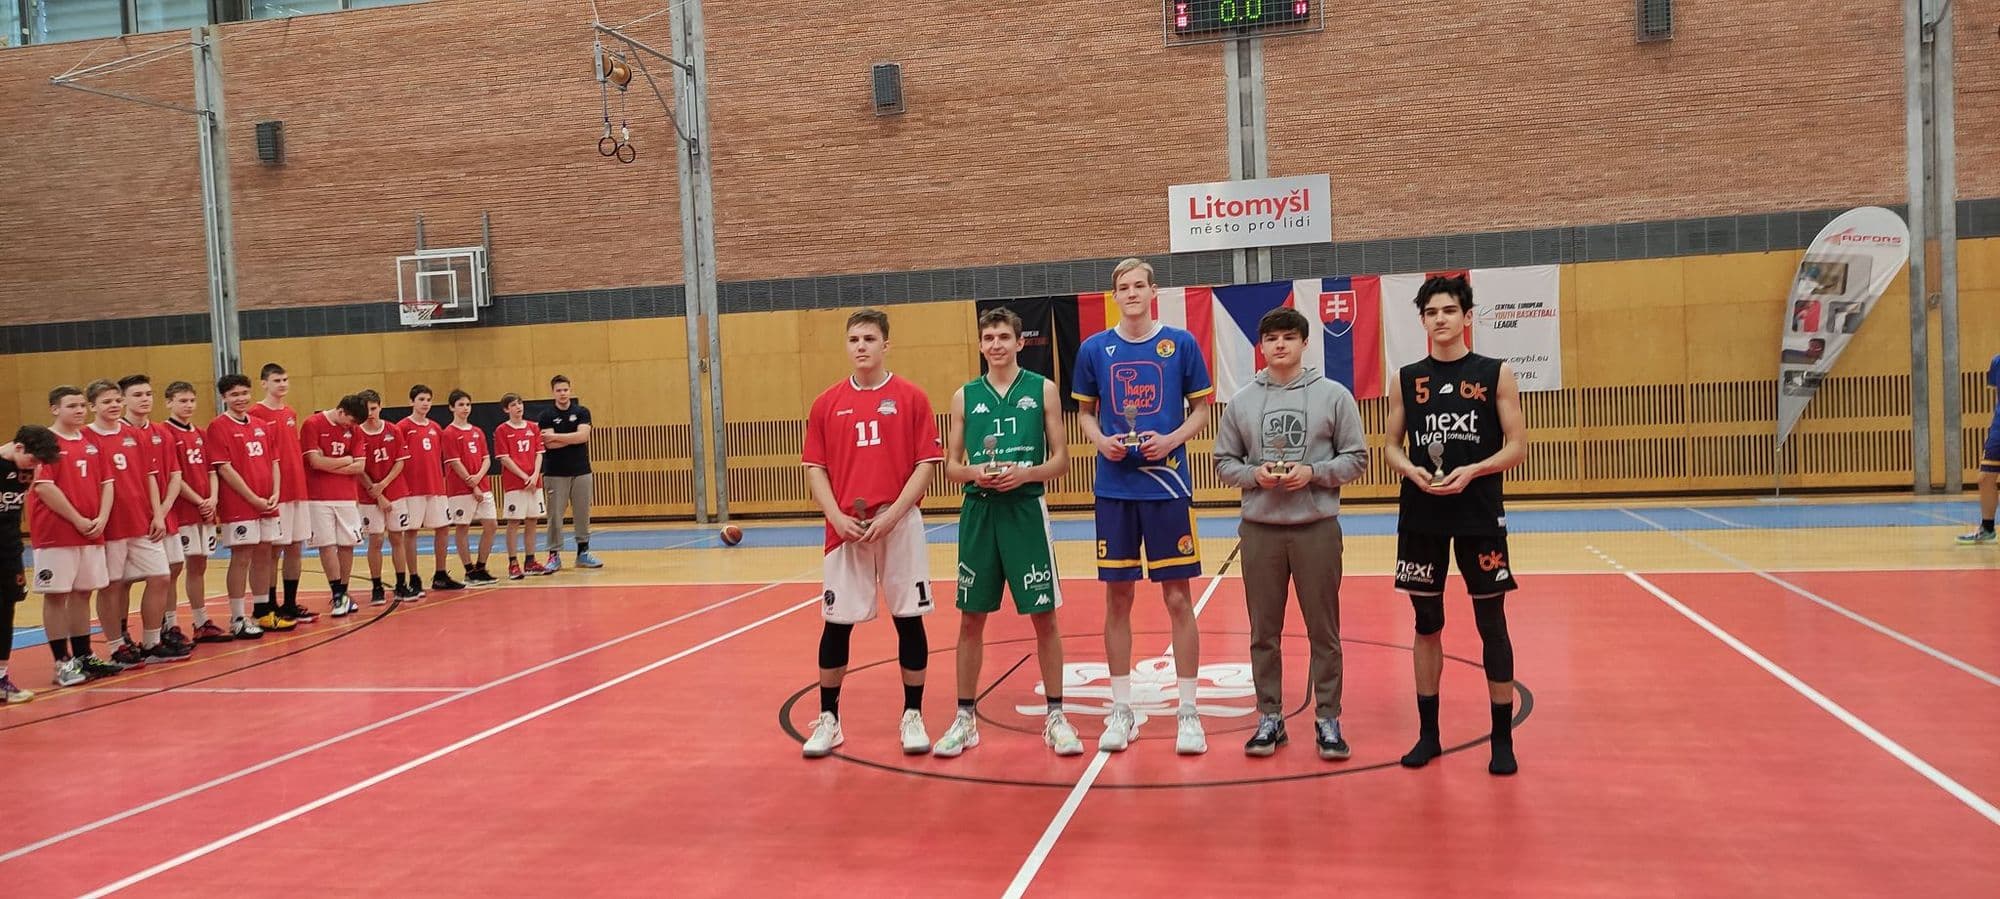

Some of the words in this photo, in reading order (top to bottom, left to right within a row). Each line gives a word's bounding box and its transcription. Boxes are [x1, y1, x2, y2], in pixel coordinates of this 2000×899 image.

[1189, 188, 1310, 221] Litomyšl
[1190, 220, 1240, 235] město
[1248, 220, 1275, 234] pro
[1283, 215, 1311, 229] lidi
[1494, 303, 1516, 311] CENTRAL
[1517, 301, 1544, 310] EUROPEAN
[1494, 311, 1516, 320] YOUTH
[1516, 309, 1557, 319] BASKETBALL
[1493, 319, 1519, 329] LEAGUE
[1415, 377, 1430, 404] 5
[1459, 379, 1488, 401] bk
[992, 416, 1017, 437] 17
[1425, 410, 1479, 433] next
[855, 420, 881, 448] 11
[1415, 427, 1448, 447] level
[1447, 430, 1481, 444] consulting
[245, 441, 264, 457] 13
[422, 437, 432, 451] 6
[468, 441, 477, 454] 5
[516, 439, 531, 453] 17
[113, 453, 128, 470] 9
[186, 448, 204, 464] 22
[373, 447, 390, 463] 21
[76, 459, 88, 478] 7
[1098, 539, 1107, 559] 5
[1396, 559, 1434, 576] next
